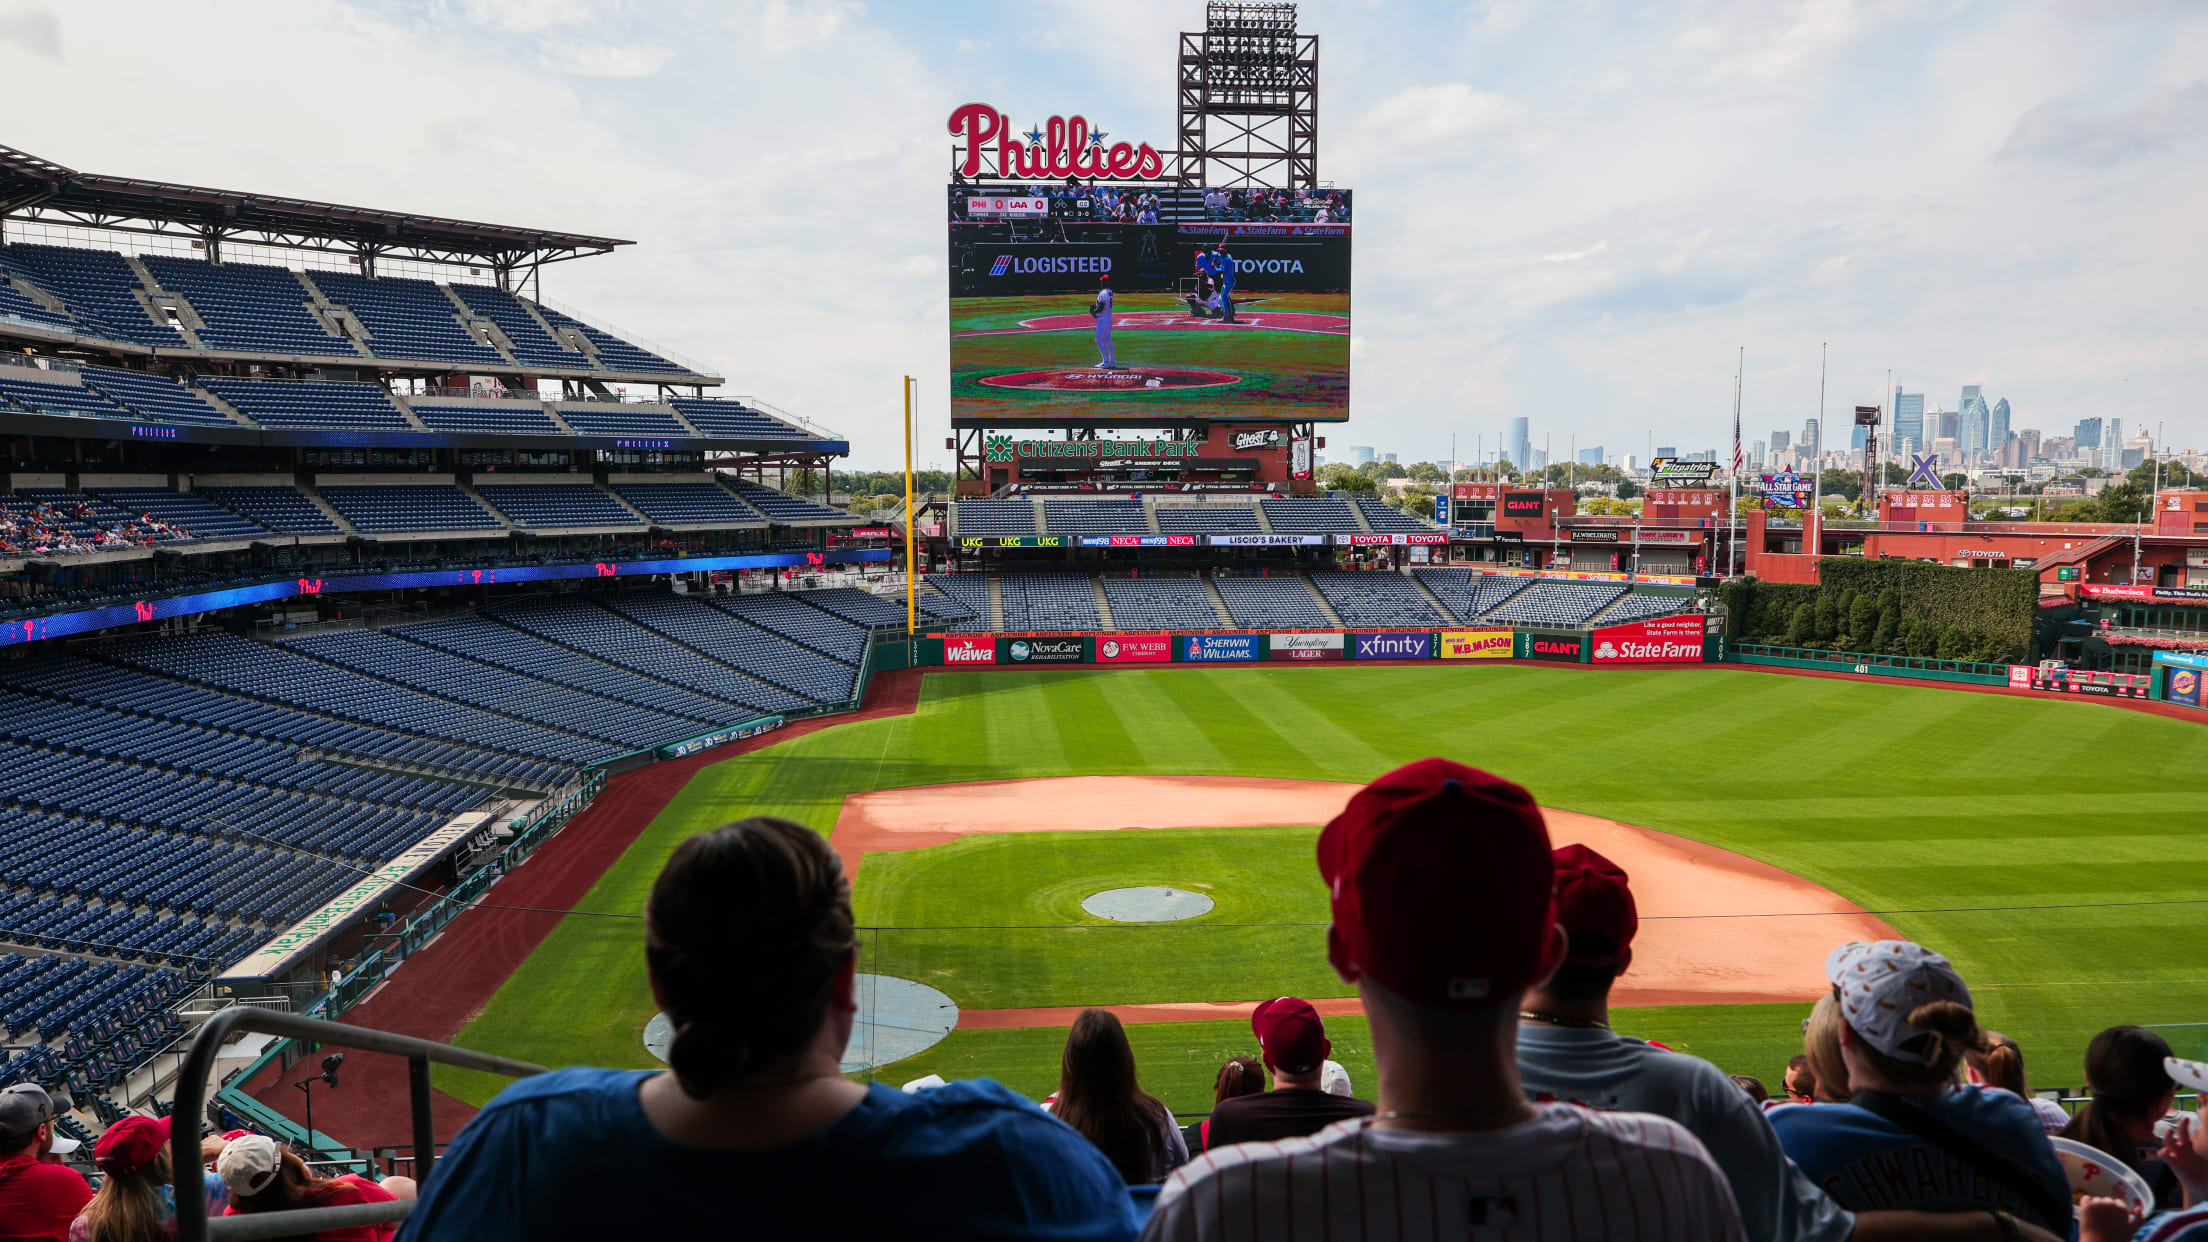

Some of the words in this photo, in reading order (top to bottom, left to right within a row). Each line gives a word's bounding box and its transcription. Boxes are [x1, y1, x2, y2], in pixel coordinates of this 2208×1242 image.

[948, 103, 1163, 179] Phillies
[995, 200, 1003, 210] 0
[1010, 201, 1027, 209] LAA
[1035, 201, 1043, 210] 0
[1014, 256, 1112, 274] LOGISTEED
[1232, 259, 1304, 274] TOYOTA
[1236, 429, 1271, 450] GHOST
[1018, 439, 1098, 457] Citizens
[1102, 438, 1151, 457] Bank
[1155, 439, 1199, 457] Park
[1656, 459, 1713, 473] Fitzpatrick
[1760, 482, 1773, 492] ALL
[1774, 481, 1792, 492] STAR
[1792, 482, 1813, 492] GAME
[1507, 501, 1540, 510] GIANT
[961, 537, 983, 547] UKG
[999, 537, 1020, 547] UKG
[1037, 537, 1058, 547] UKG
[1113, 537, 1137, 545] NECA
[1170, 537, 1194, 545] NECA
[1229, 535, 1266, 544] LISCIO'S
[1268, 535, 1304, 544] BAKERY
[1353, 535, 1389, 543] TOYOTA
[1410, 535, 1445, 543] TOYOTA
[1971, 550, 2006, 558] TOYOTA
[2101, 587, 2145, 596] Budweiser
[1122, 642, 1138, 651] F.W.
[1140, 642, 1167, 651] WEBB
[1204, 637, 1250, 648] SHERWIN
[1284, 635, 1329, 648] Yuengling
[1360, 635, 1425, 656] xfinity
[1031, 641, 1082, 653] NovaCare
[1533, 641, 1580, 655] GIANT
[947, 646, 993, 661] Wawa
[1292, 650, 1321, 658] LAGER
[1854, 664, 1868, 674] 401
[2082, 685, 2109, 693] TOYOTA
[404, 823, 475, 858] WELCOME
[259, 932, 318, 955] Park
